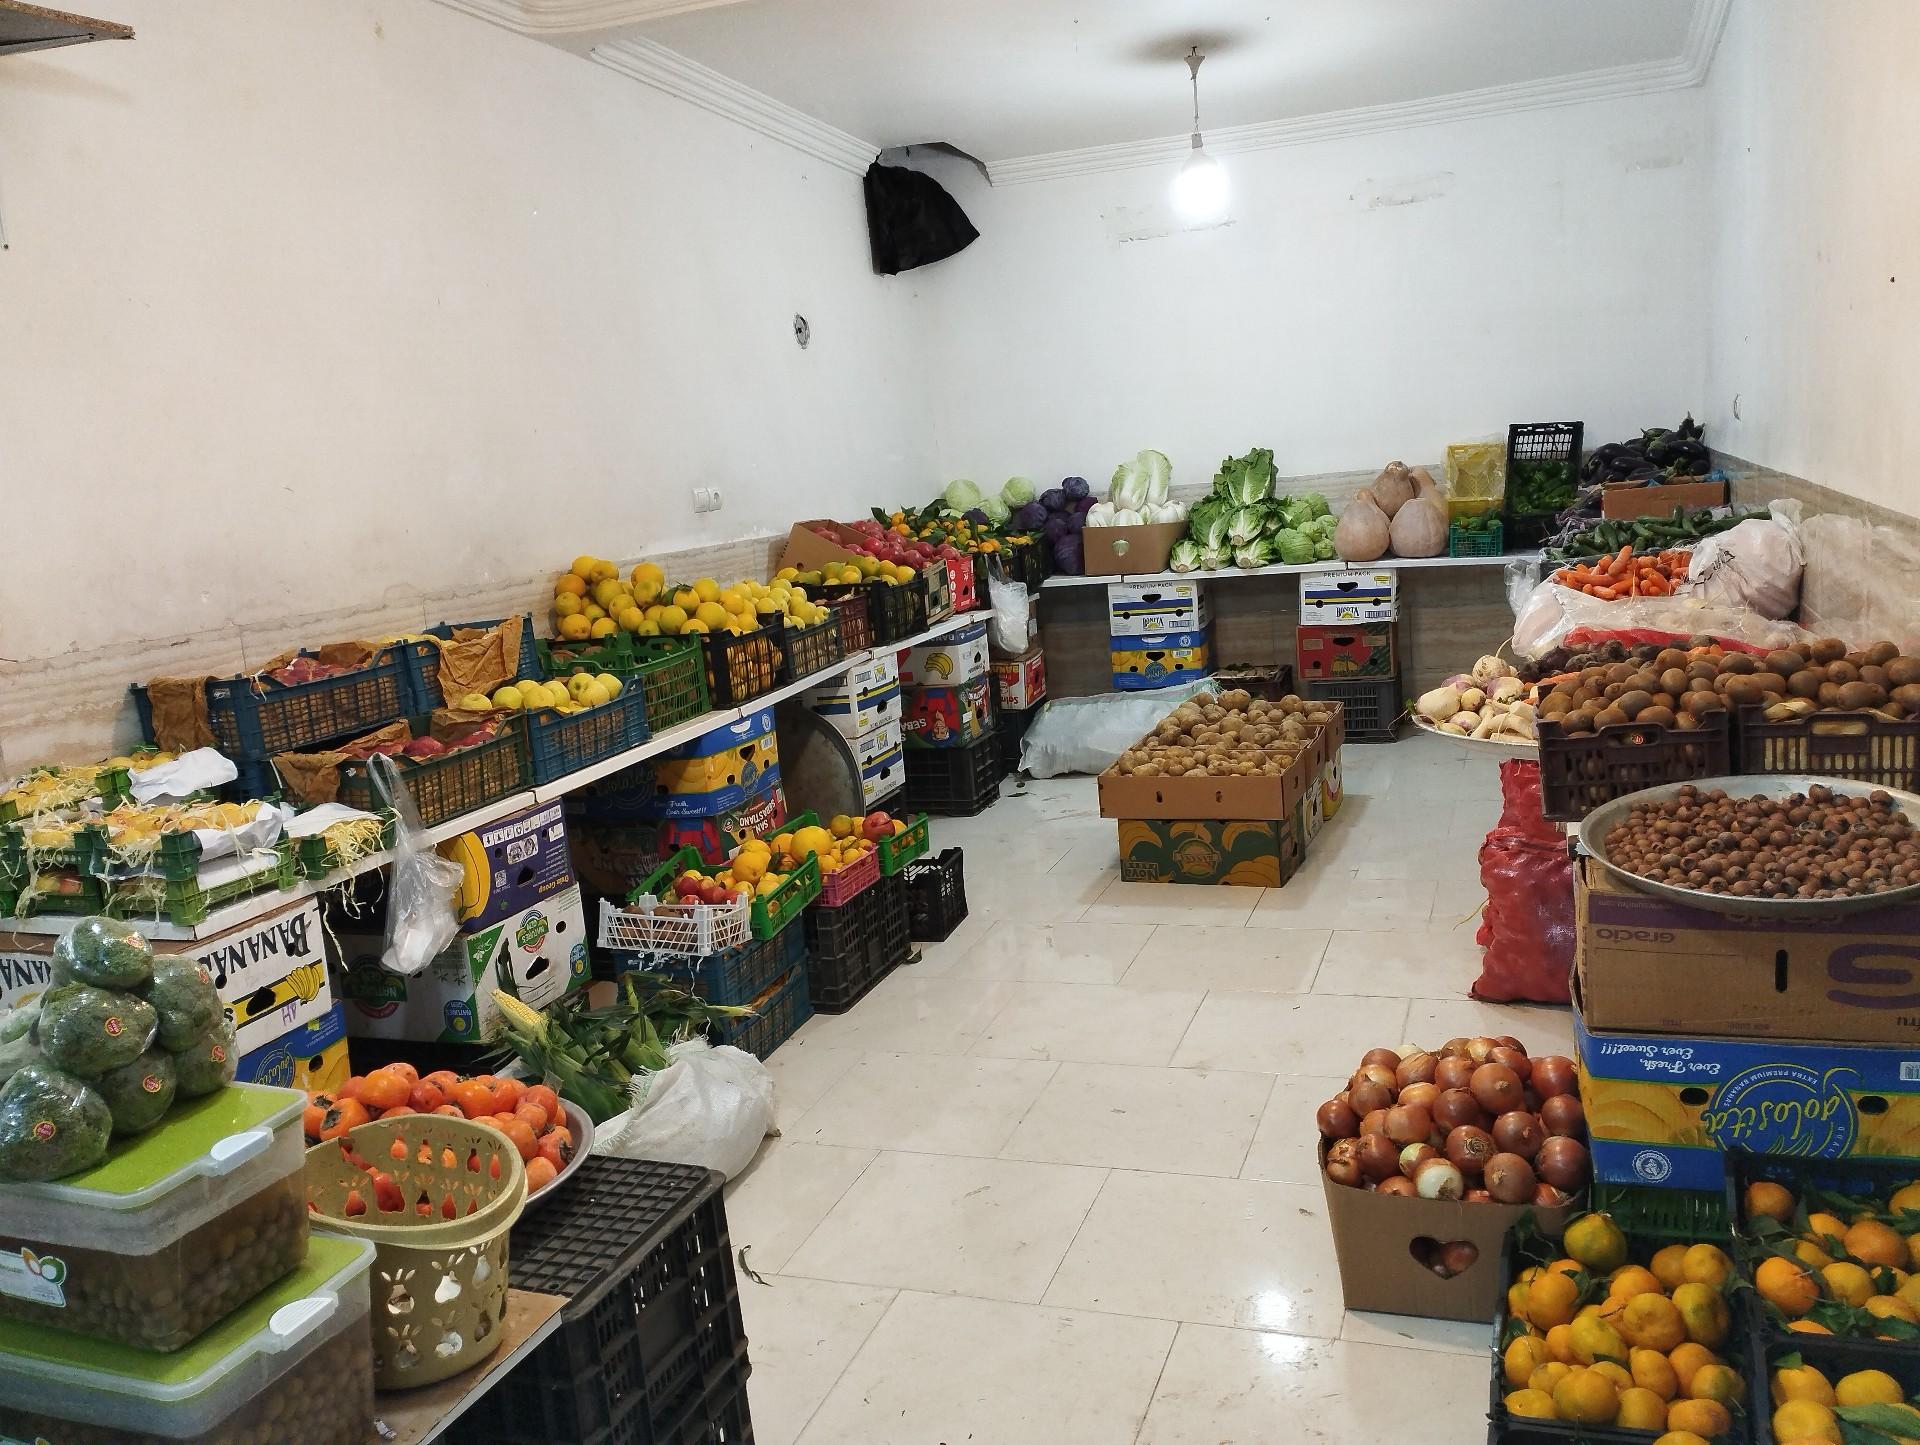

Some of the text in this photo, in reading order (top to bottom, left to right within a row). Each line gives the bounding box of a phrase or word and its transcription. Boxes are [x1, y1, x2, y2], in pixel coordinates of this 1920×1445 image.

[739, 799, 776, 827] SEBASTIANO
[755, 820, 769, 836] SAN
[1600, 1043, 1694, 1060] Ever Sweet!!!
[1639, 1058, 1721, 1075] Ever Fresh,
[1723, 1069, 1818, 1108] EXTRA PREMIUM BANANAS
